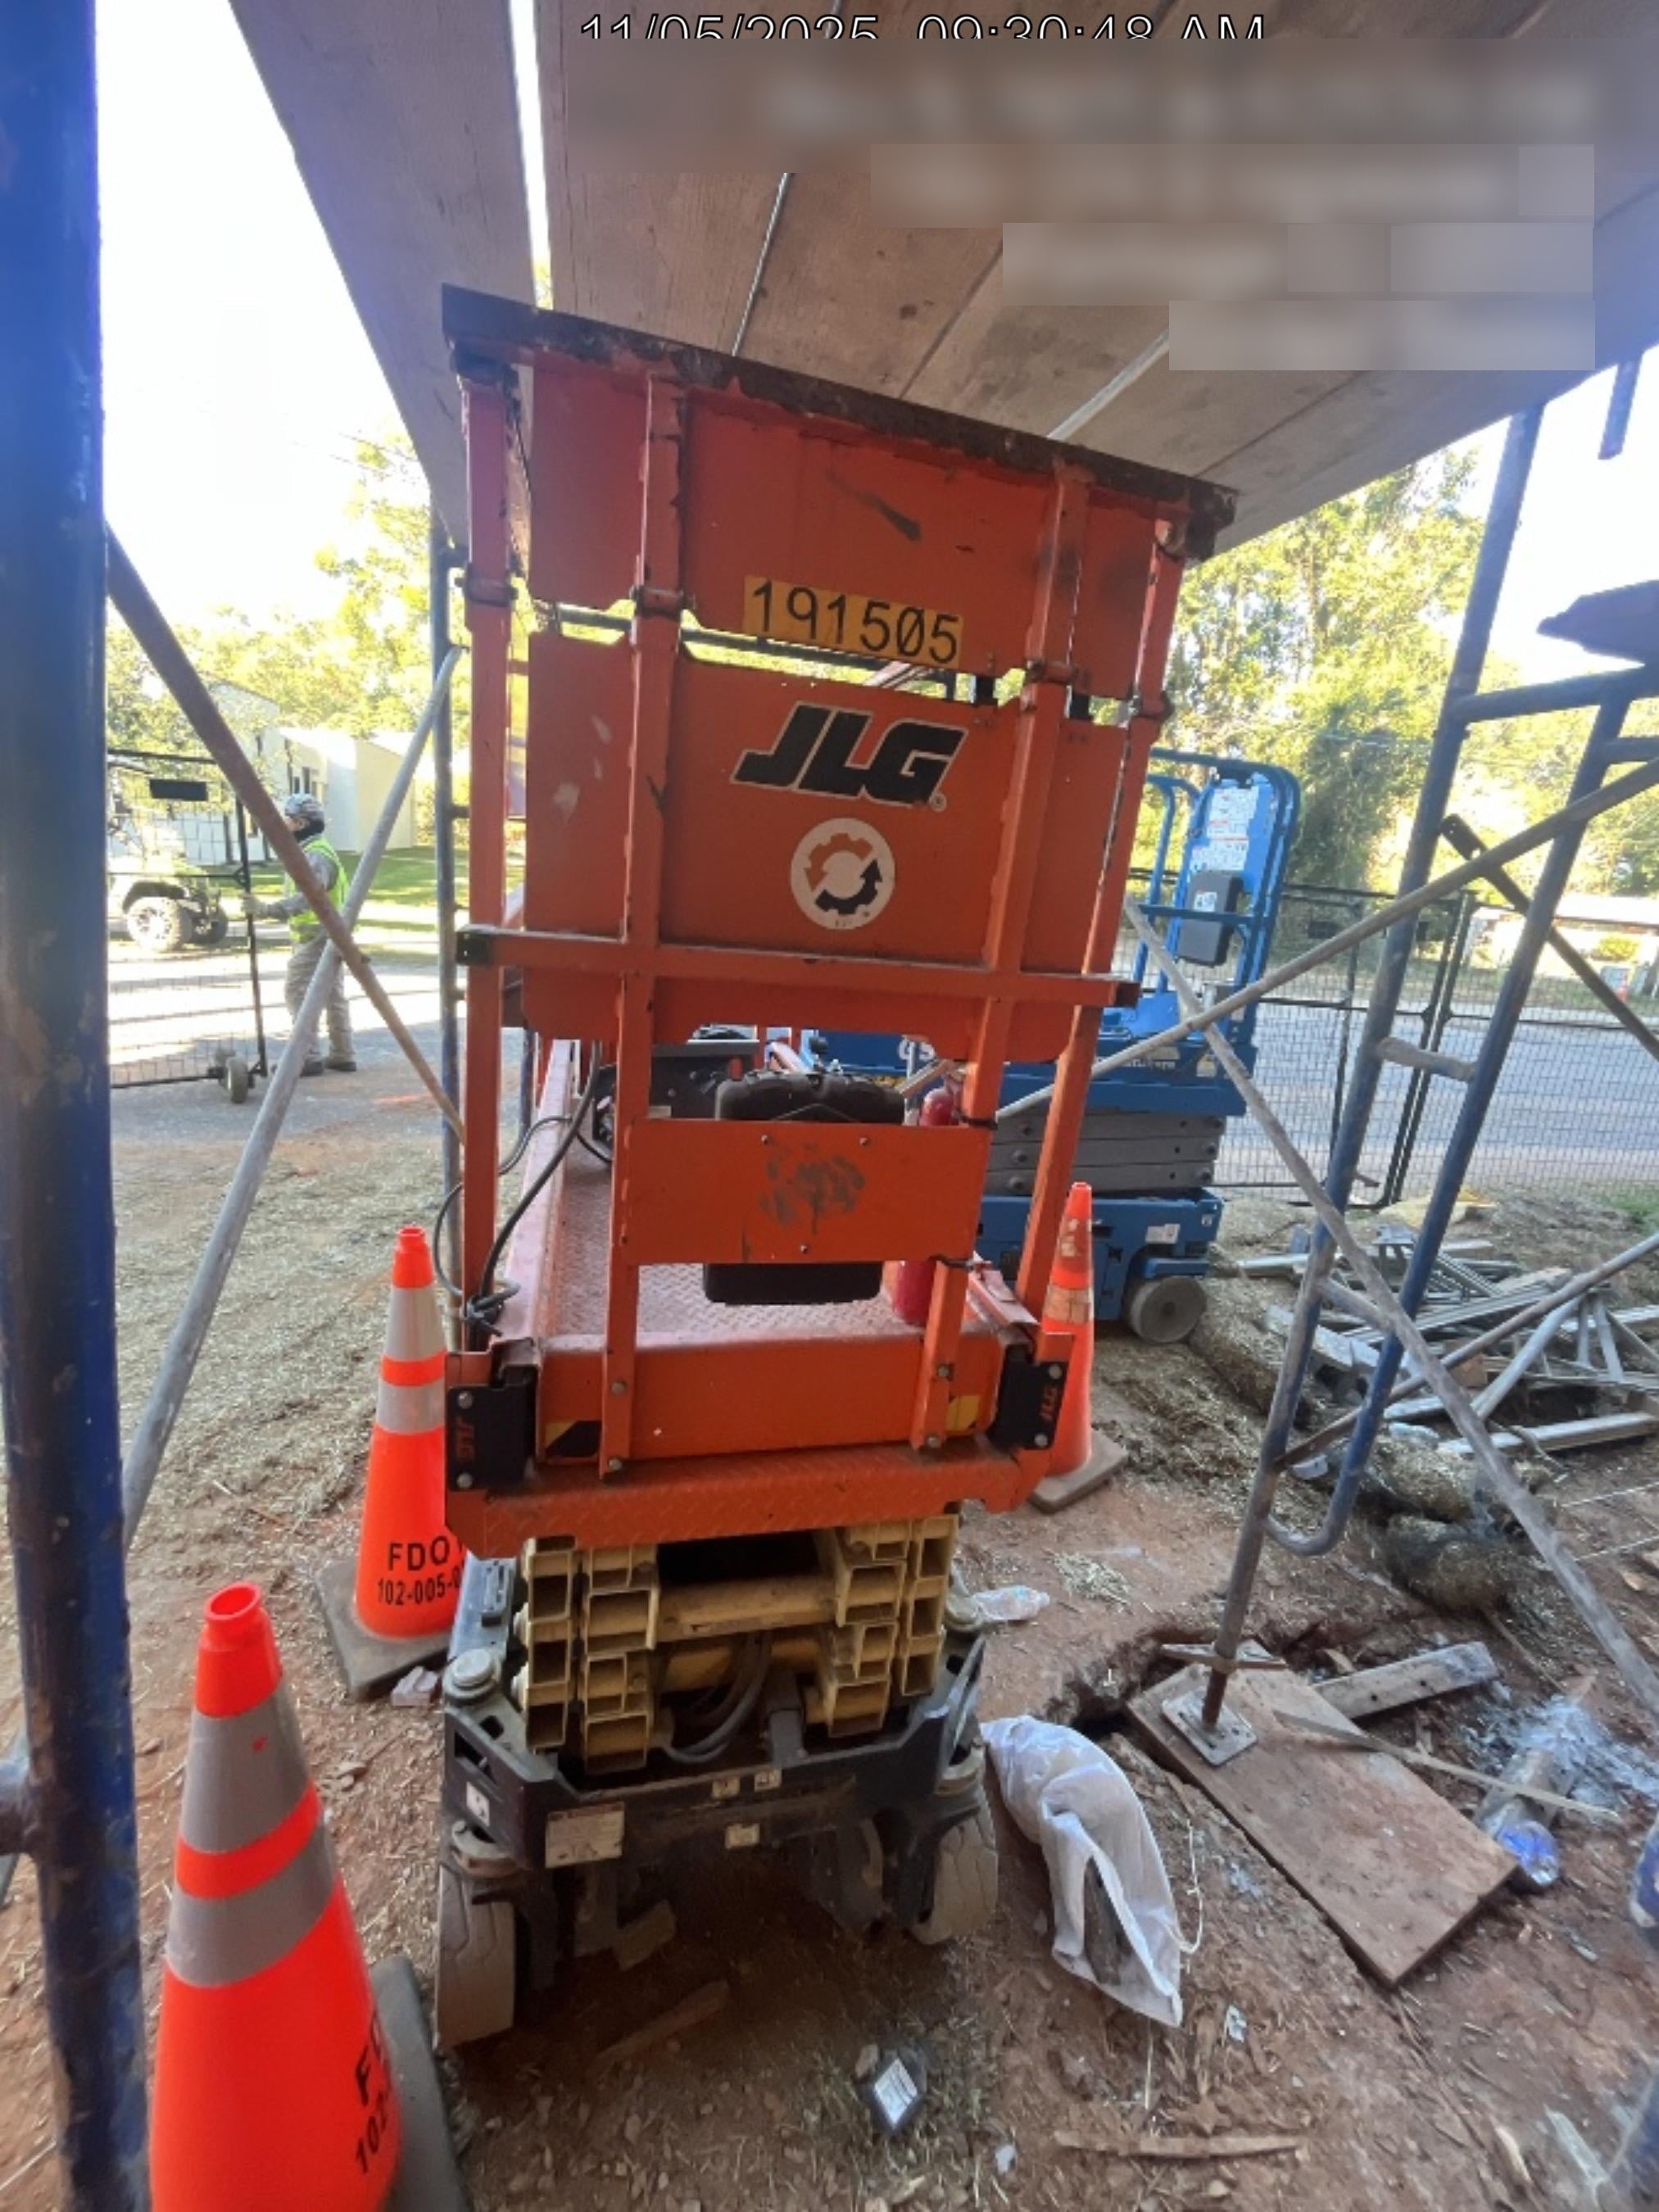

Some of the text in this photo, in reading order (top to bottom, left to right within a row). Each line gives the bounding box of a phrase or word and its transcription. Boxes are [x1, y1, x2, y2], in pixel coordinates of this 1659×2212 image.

[751, 578, 960, 664] 191505
[731, 701, 968, 808] JLG
[388, 1534, 464, 1571] FDO
